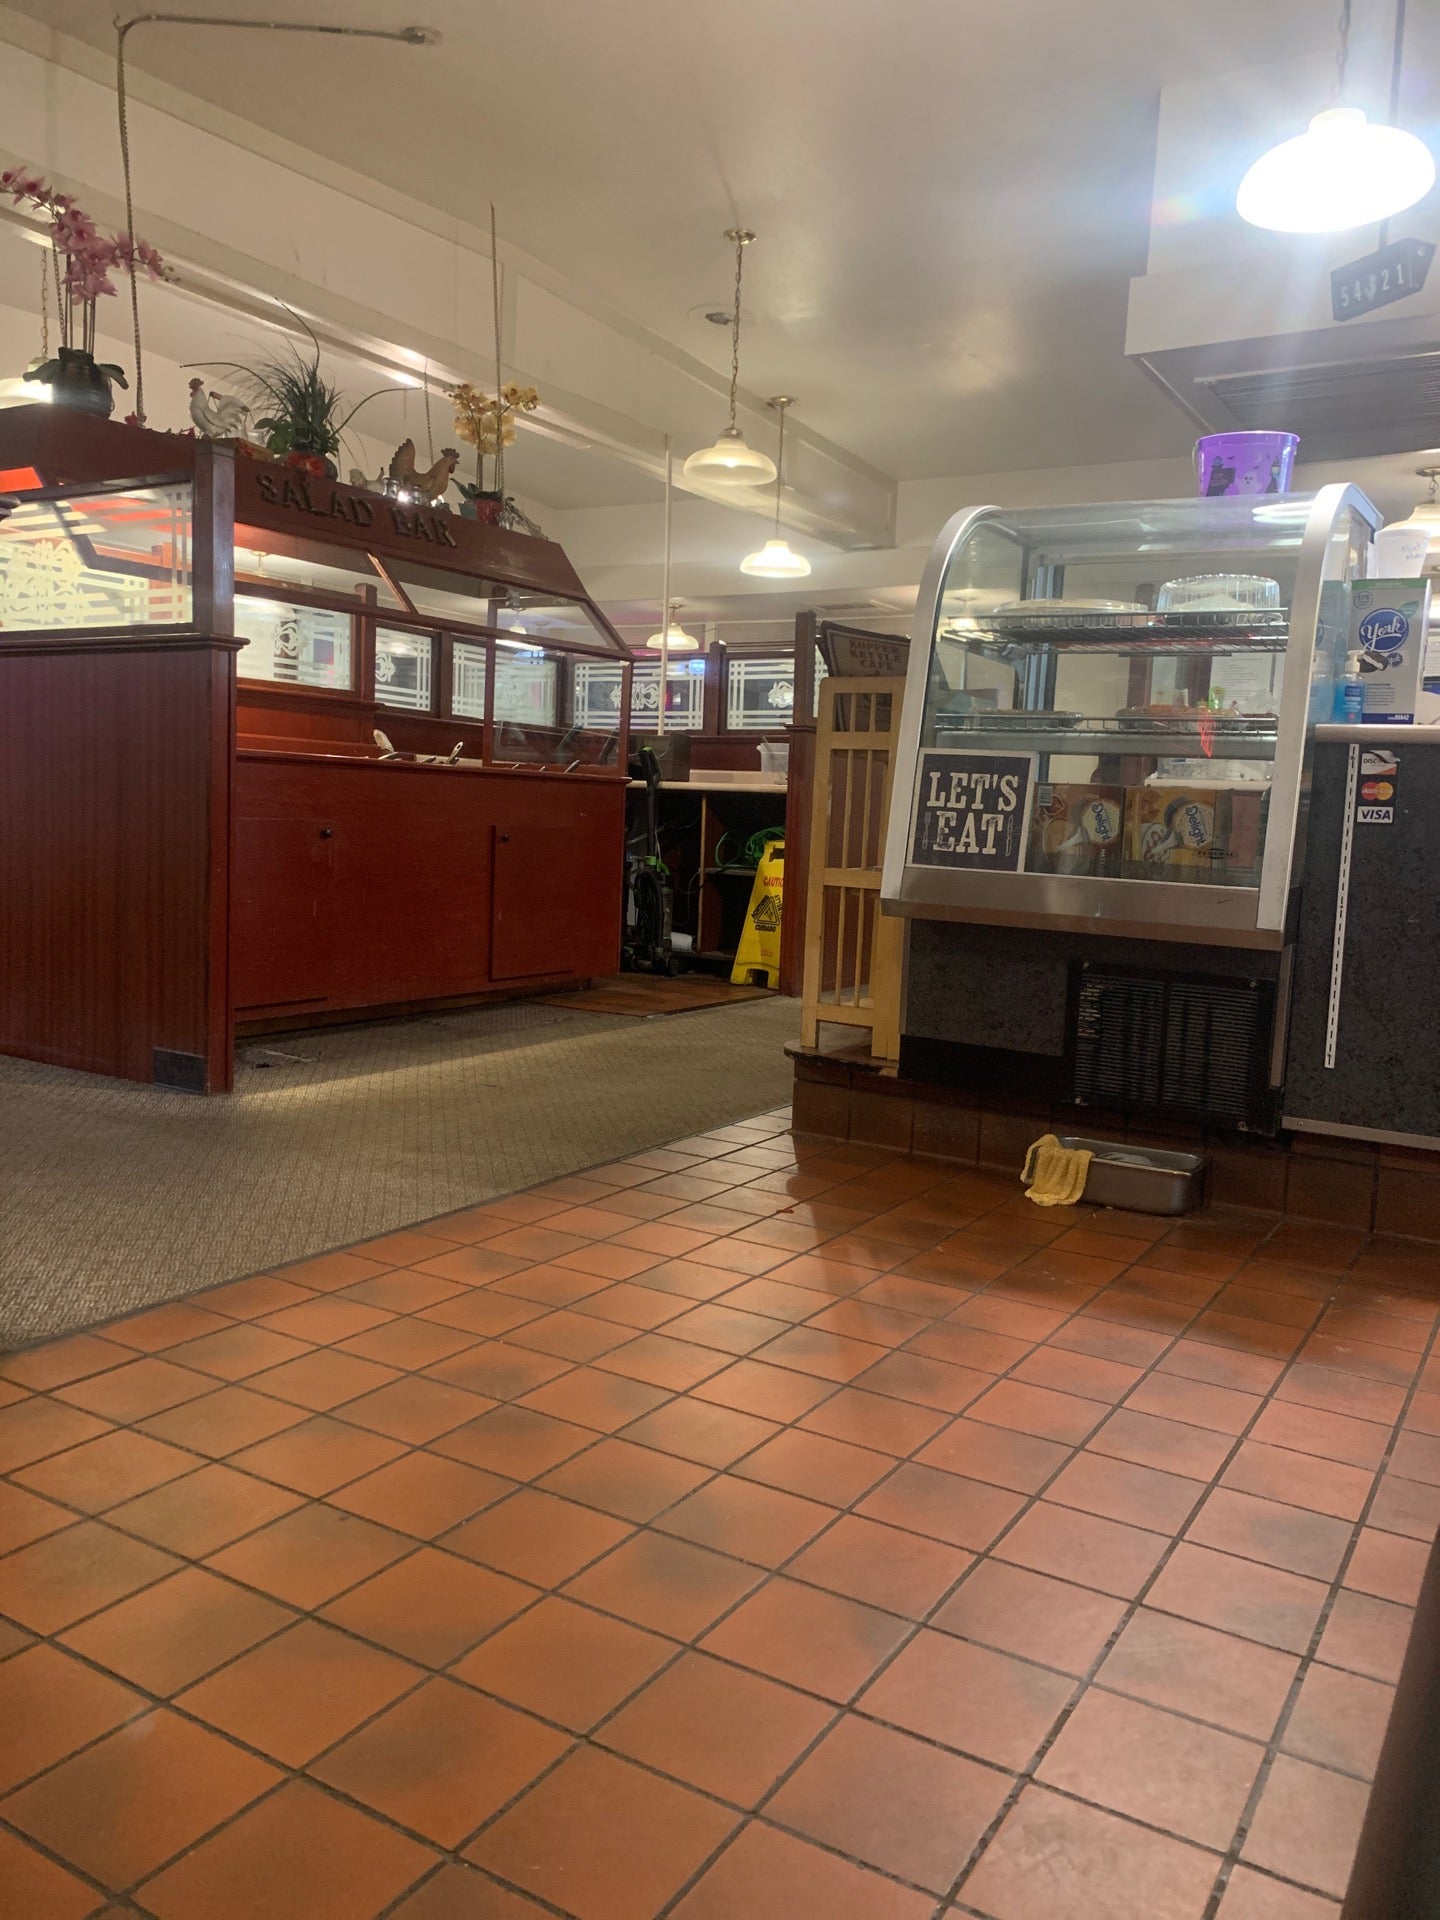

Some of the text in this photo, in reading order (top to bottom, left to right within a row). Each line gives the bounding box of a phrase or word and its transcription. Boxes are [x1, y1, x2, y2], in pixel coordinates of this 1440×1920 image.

[256, 472, 458, 548] SALAD BAR
[1360, 614, 1405, 651] York
[861, 659, 895, 671] CAFE
[926, 771, 1018, 812] LET'S
[932, 810, 1004, 855] EAT
[1092, 803, 1111, 842] Delight
[1185, 805, 1206, 847] Delight
[1361, 809, 1391, 820] VISA
[763, 876, 783, 888] CAUTIO
